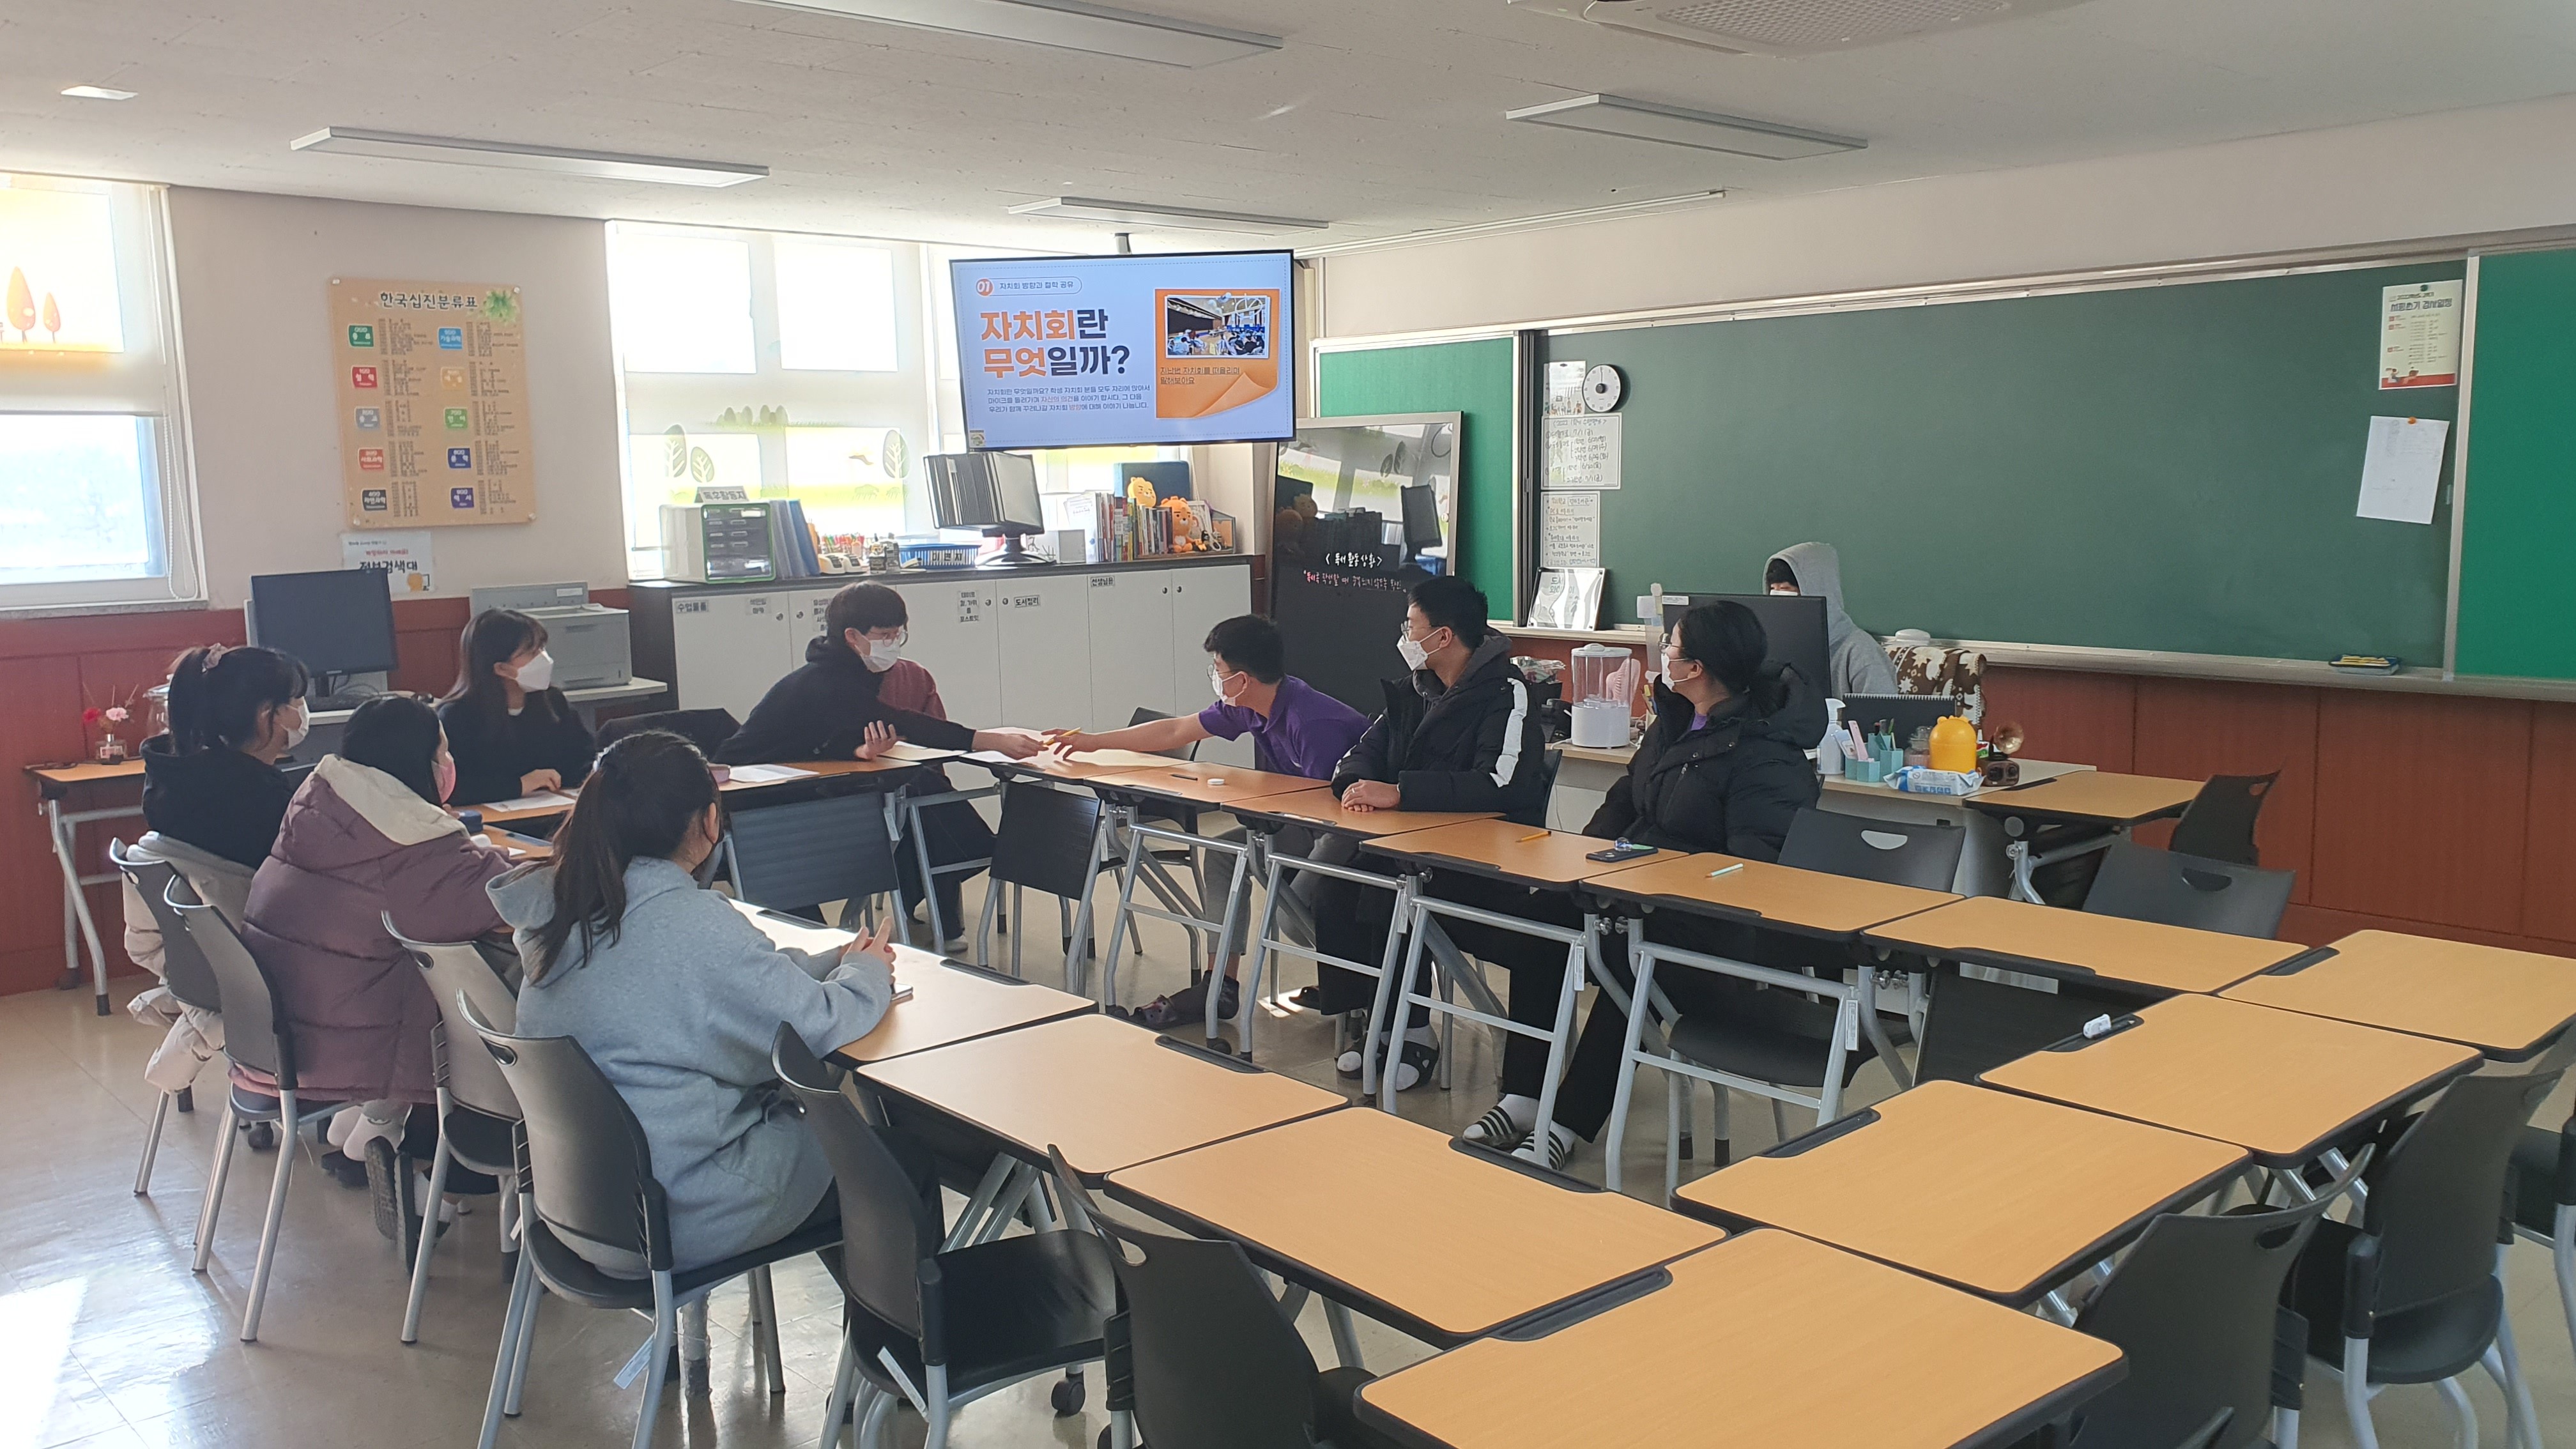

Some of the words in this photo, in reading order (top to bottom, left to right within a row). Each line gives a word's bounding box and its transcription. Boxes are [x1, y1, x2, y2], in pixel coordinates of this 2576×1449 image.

[978, 281, 990, 292] 01
[380, 292, 477, 309] 한국십진분류표
[980, 309, 1108, 341] 자치회란
[984, 346, 1130, 378] 무엇일까?
[678, 601, 707, 611] 수업물품
[1016, 597, 1039, 606] 도서정리
